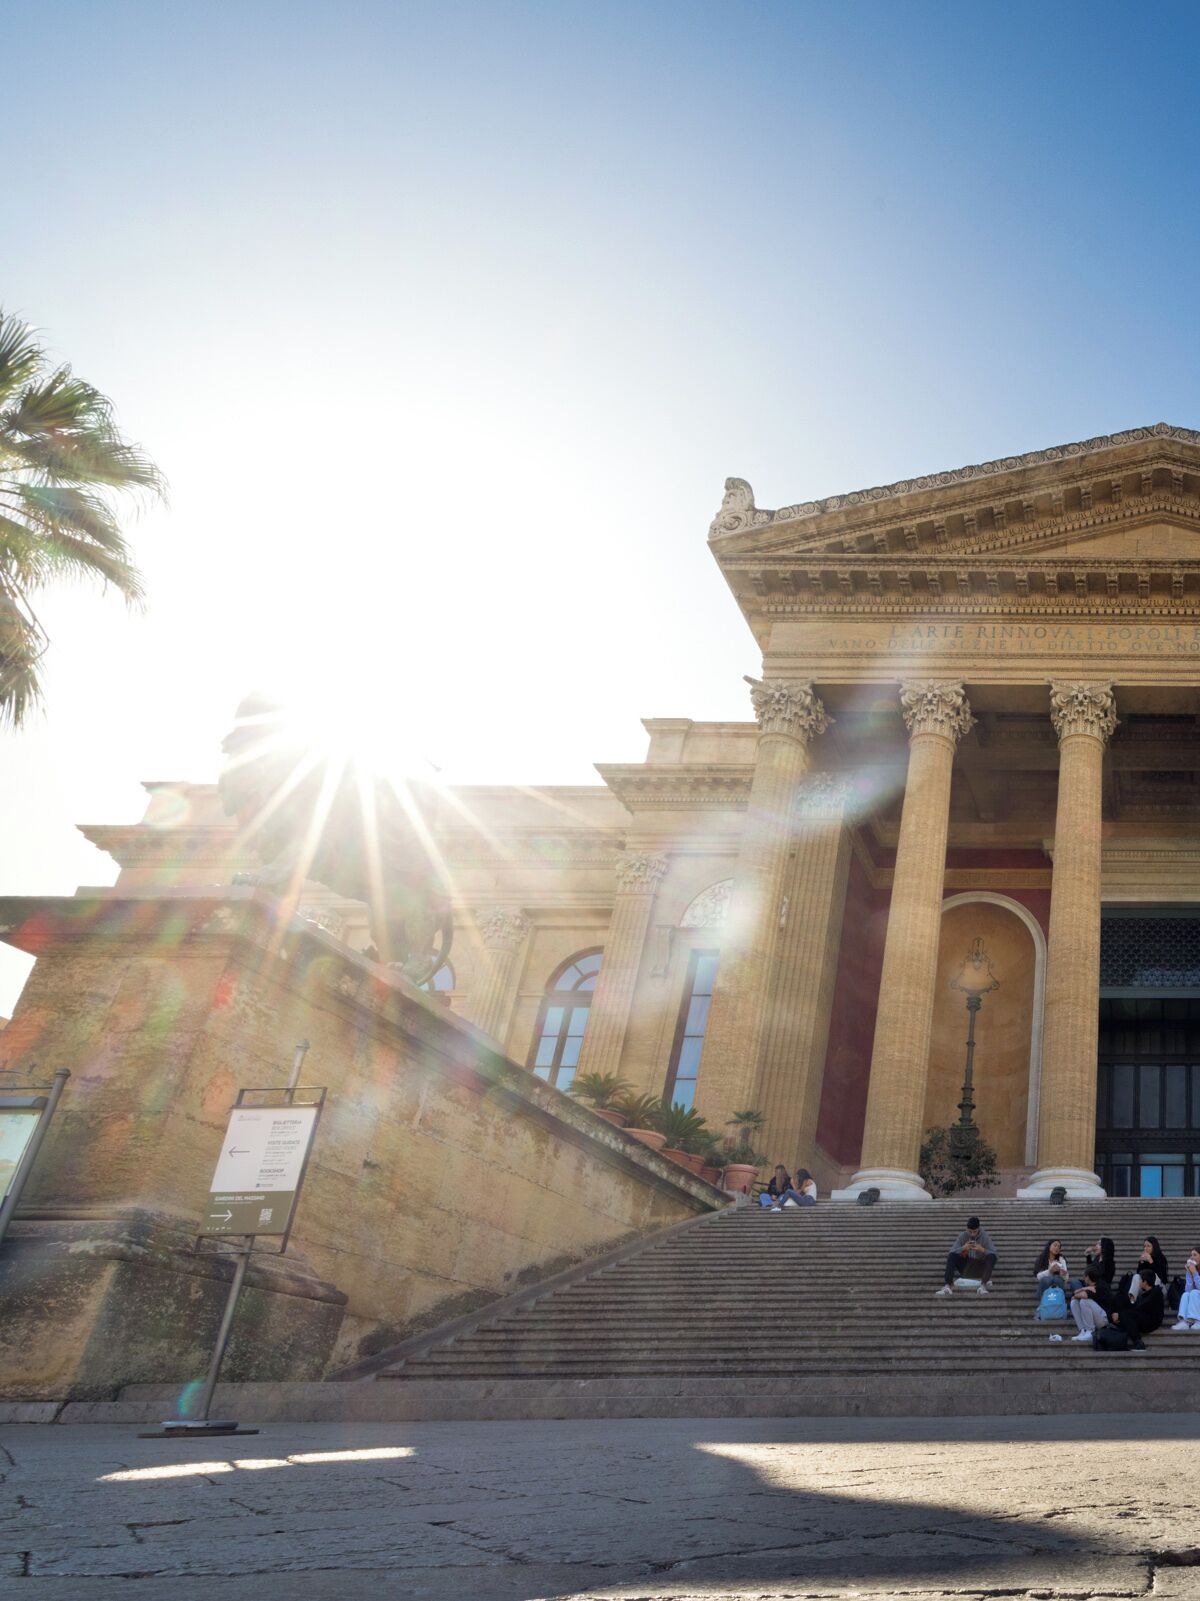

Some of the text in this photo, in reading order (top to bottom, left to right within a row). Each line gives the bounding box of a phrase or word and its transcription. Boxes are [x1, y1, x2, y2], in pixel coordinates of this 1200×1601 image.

[890, 625, 964, 639] L'ARTE
[976, 626, 1075, 640] RINNOVA
[1106, 627, 1182, 640] POPOLI
[828, 639, 877, 649] VANO
[887, 639, 936, 650] DELLE
[949, 640, 1008, 650] SCENE
[1020, 640, 1035, 650] IL
[1047, 640, 1118, 651] DILETTO
[1131, 641, 1164, 651] OVE
